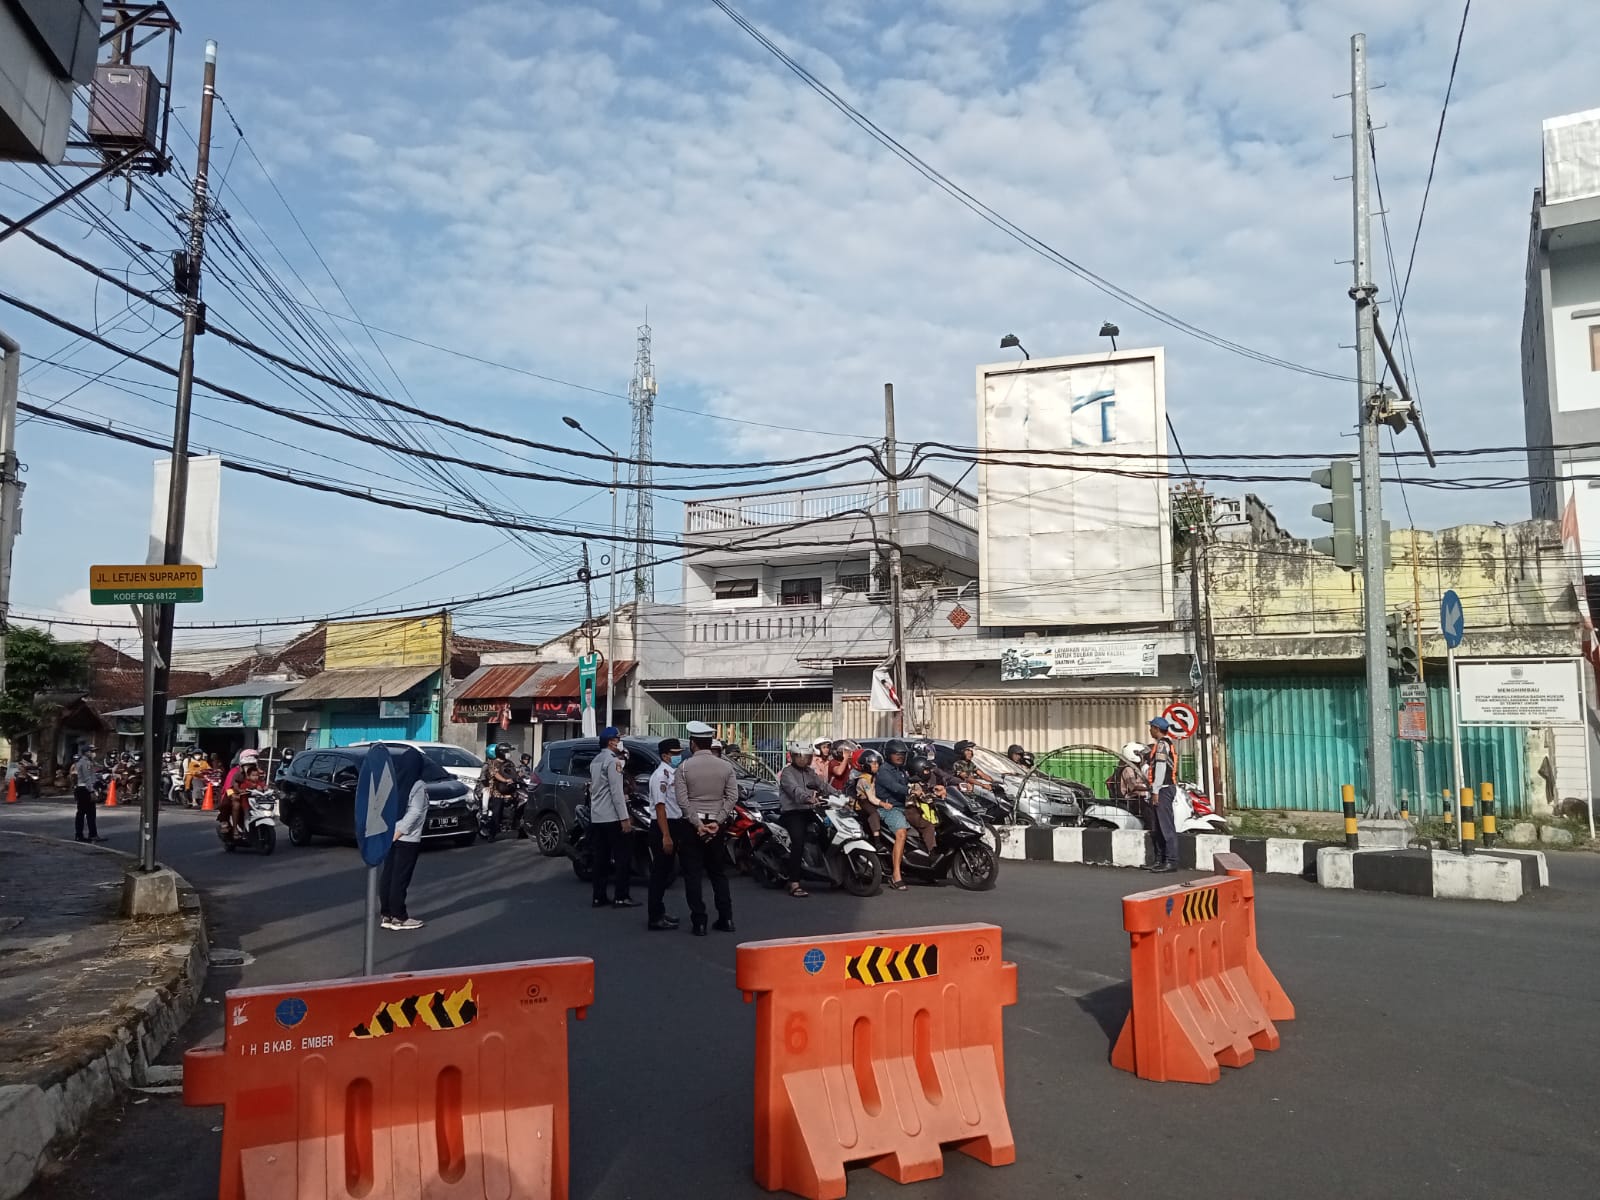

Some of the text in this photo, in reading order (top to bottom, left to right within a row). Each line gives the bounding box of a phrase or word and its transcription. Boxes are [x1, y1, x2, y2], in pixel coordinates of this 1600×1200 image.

[112, 572, 147, 583] LETJEN
[149, 571, 198, 582] SUPRAPTO
[113, 592, 177, 601] KODE POS 68122
